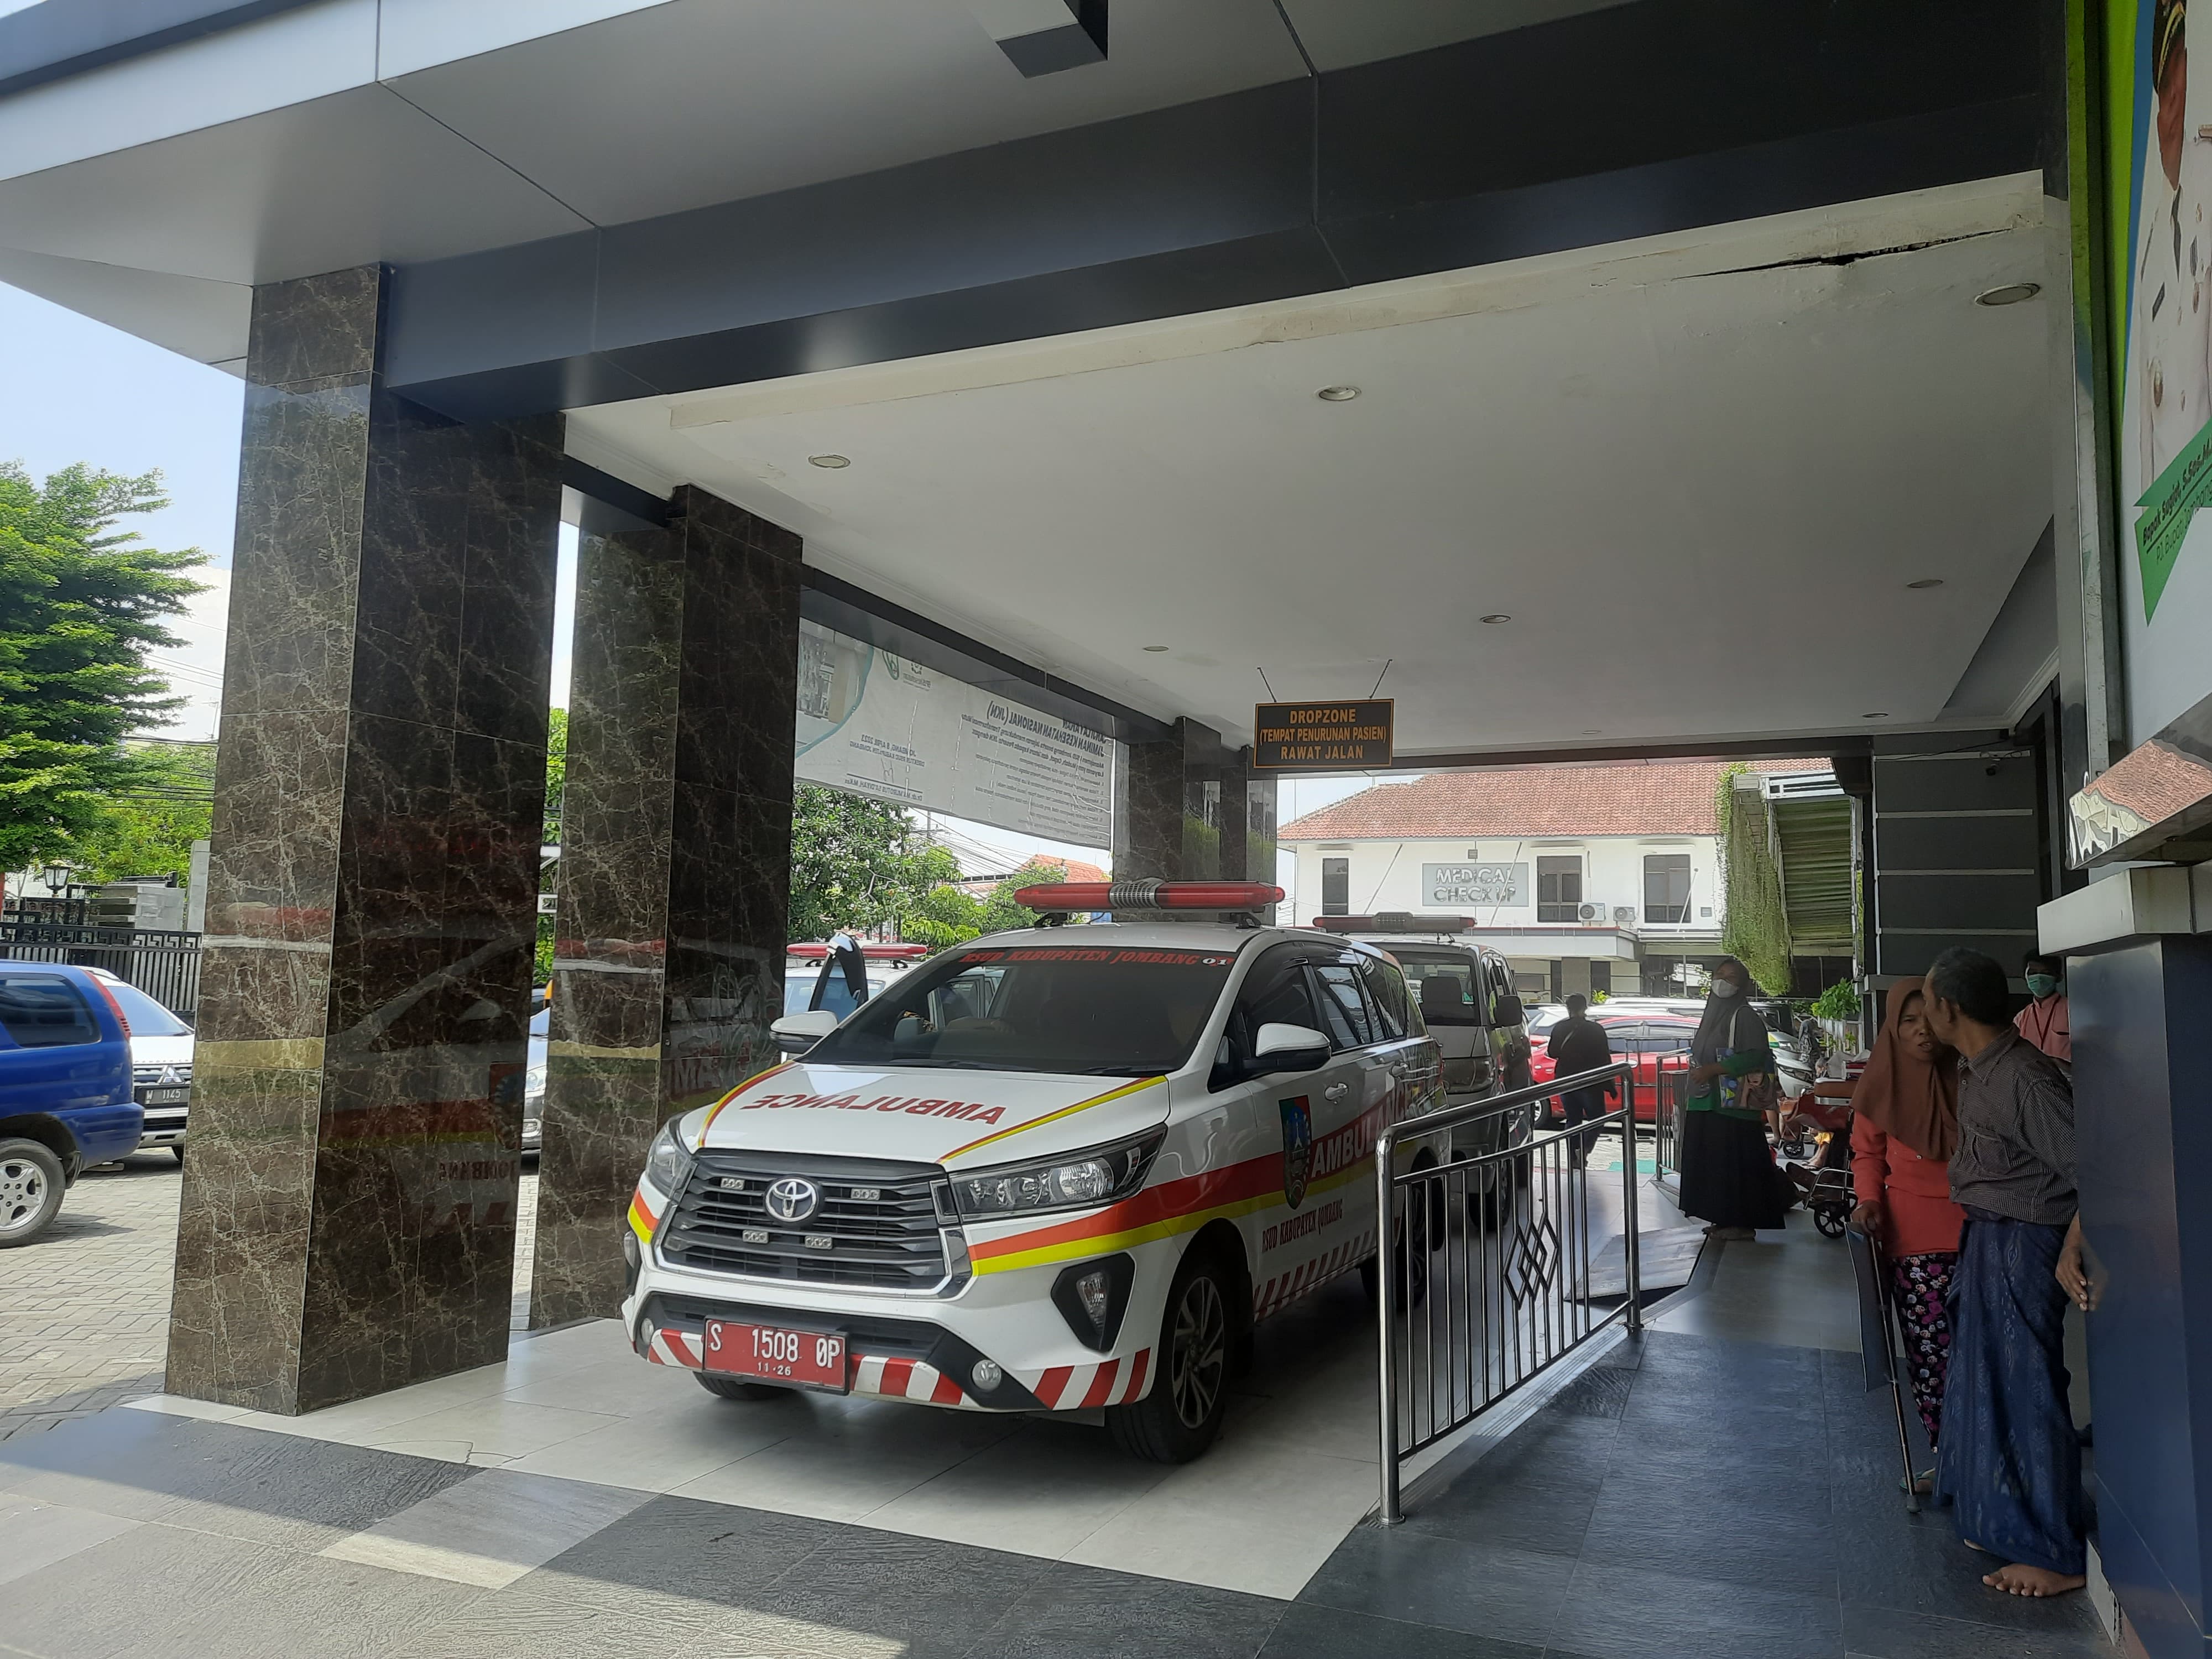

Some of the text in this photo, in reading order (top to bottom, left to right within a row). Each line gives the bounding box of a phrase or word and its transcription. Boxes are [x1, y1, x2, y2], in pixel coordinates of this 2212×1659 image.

[2143, 508, 2161, 546] Bapak
[2164, 518, 2184, 555] Bupati
[1290, 708, 1356, 724] DROPZONE
[1260, 726, 1387, 745] (TEMPAT PENURUNAN PASIEN)
[1281, 745, 1364, 760] RAWAT JALAN
[1436, 867, 1515, 884] MEDICAL
[1433, 886, 1516, 902] CHECK UP
[959, 952, 1005, 963] RSUD
[1005, 950, 1110, 962] KABUPATEN
[1109, 950, 1201, 965] JOMBANG
[1261, 1198, 1344, 1253] RSUD KABUPATEN JOMBANG
[710, 1323, 722, 1351] S
[752, 1328, 799, 1363] 1508
